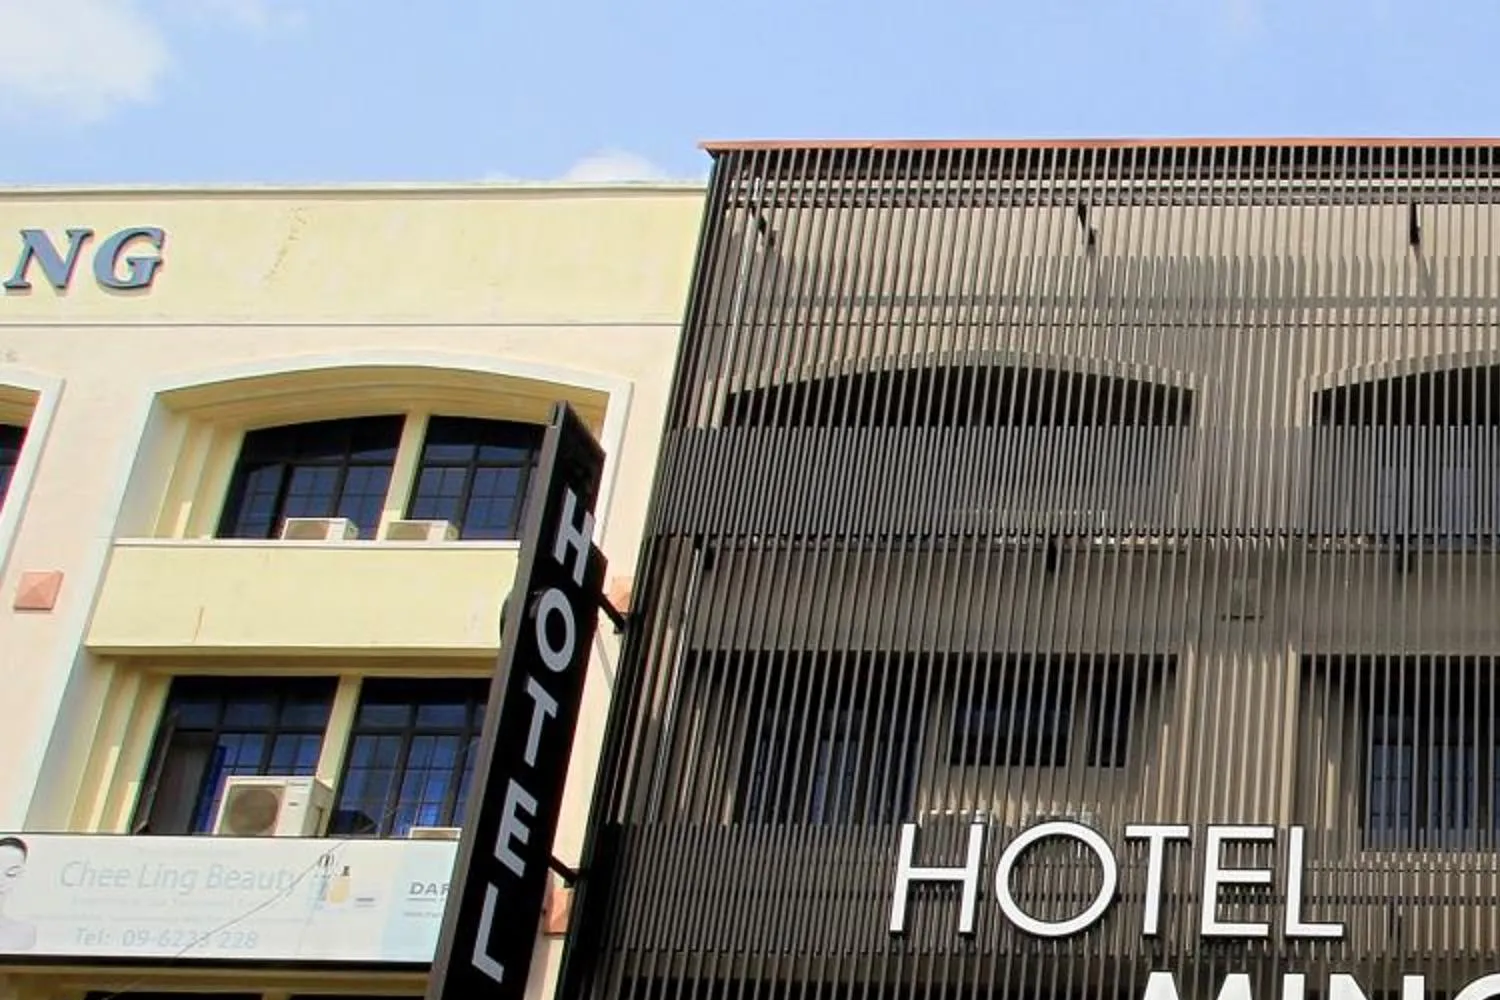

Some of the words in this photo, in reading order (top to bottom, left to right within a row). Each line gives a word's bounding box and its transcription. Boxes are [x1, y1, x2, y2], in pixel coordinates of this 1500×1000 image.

[472, 487, 596, 984] HOTEL
[59, 859, 130, 888] Chee
[138, 861, 202, 898] Ling
[889, 820, 1345, 938] HOTEL
